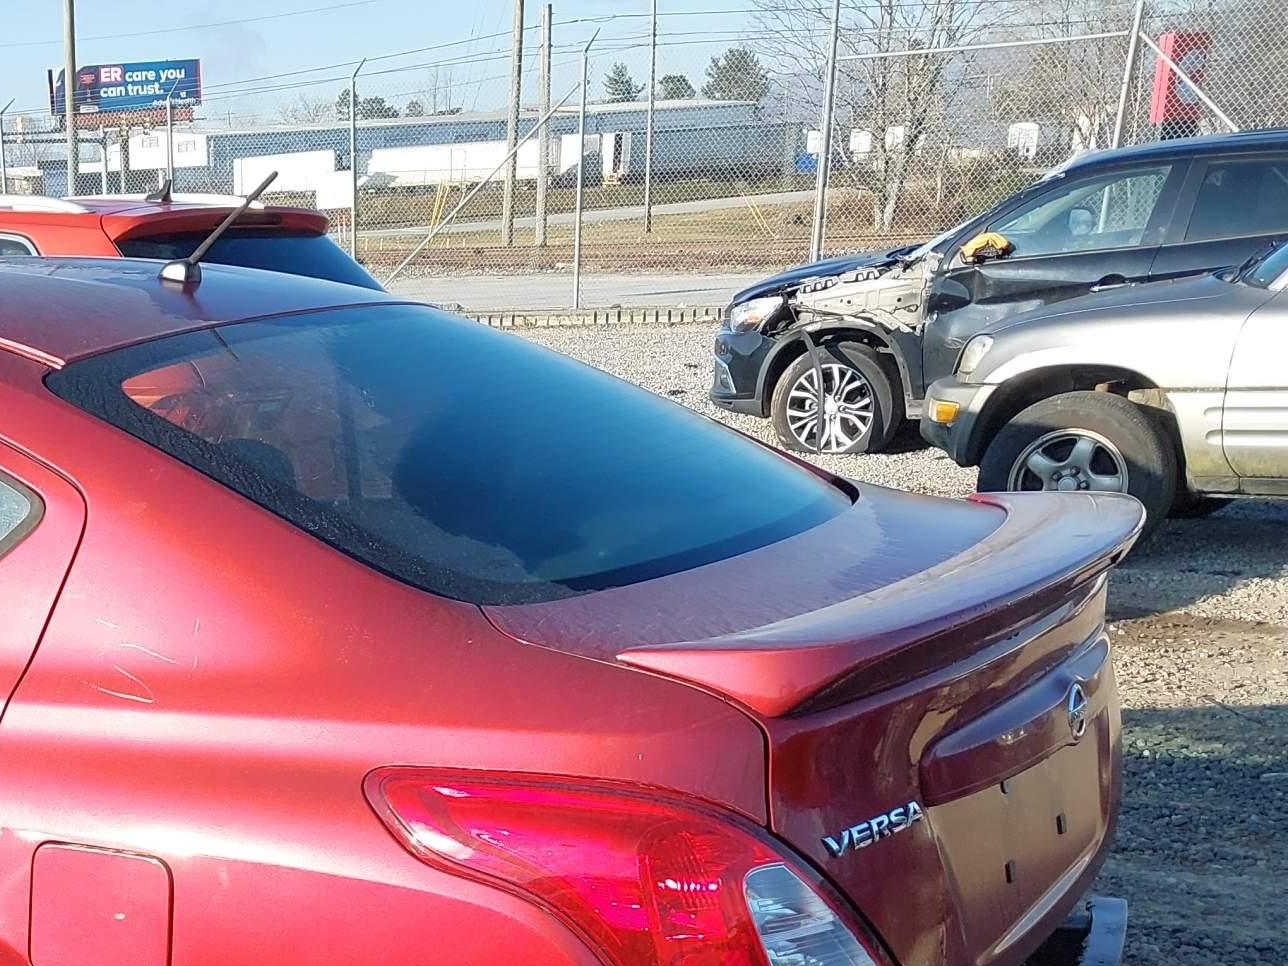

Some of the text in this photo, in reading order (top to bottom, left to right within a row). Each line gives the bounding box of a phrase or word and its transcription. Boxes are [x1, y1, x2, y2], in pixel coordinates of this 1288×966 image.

[100, 67, 122, 82] ER
[125, 70, 156, 82] care
[159, 68, 185, 81] you
[100, 82, 164, 97] can trust.
[821, 800, 923, 857] VERSA
